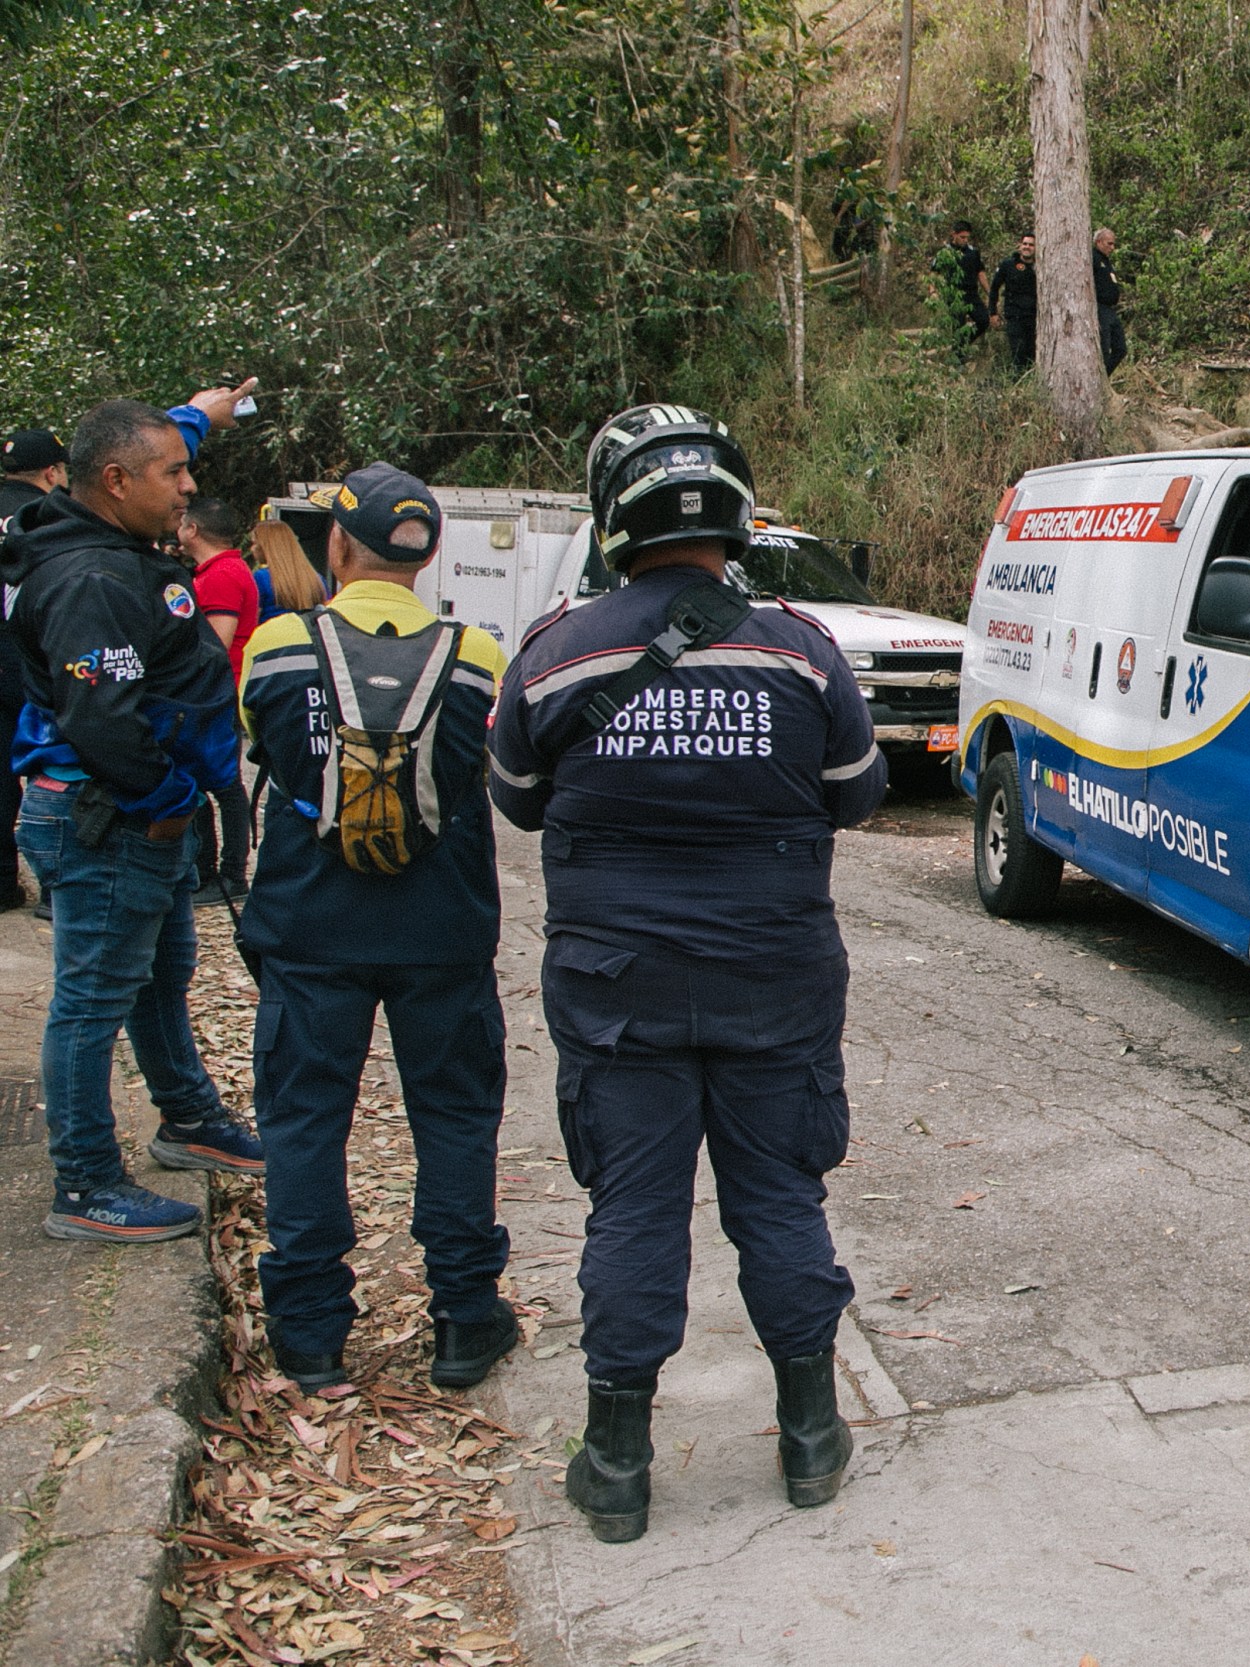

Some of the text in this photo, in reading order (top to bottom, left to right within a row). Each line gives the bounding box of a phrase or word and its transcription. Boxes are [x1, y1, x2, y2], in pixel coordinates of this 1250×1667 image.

[682, 499, 700, 508] DOT
[1019, 506, 1160, 540] EMERGENCIA LAS 24/7
[986, 563, 1057, 595] AMBULANCIA
[987, 619, 1034, 645] EMERGENCIA
[115, 667, 145, 682] Paz
[605, 710, 772, 733] ORESTALES
[596, 735, 772, 756] INPARQUES
[1068, 772, 1231, 876] EL HATILLO POSIBLE
[86, 1207, 127, 1226] HOKA
